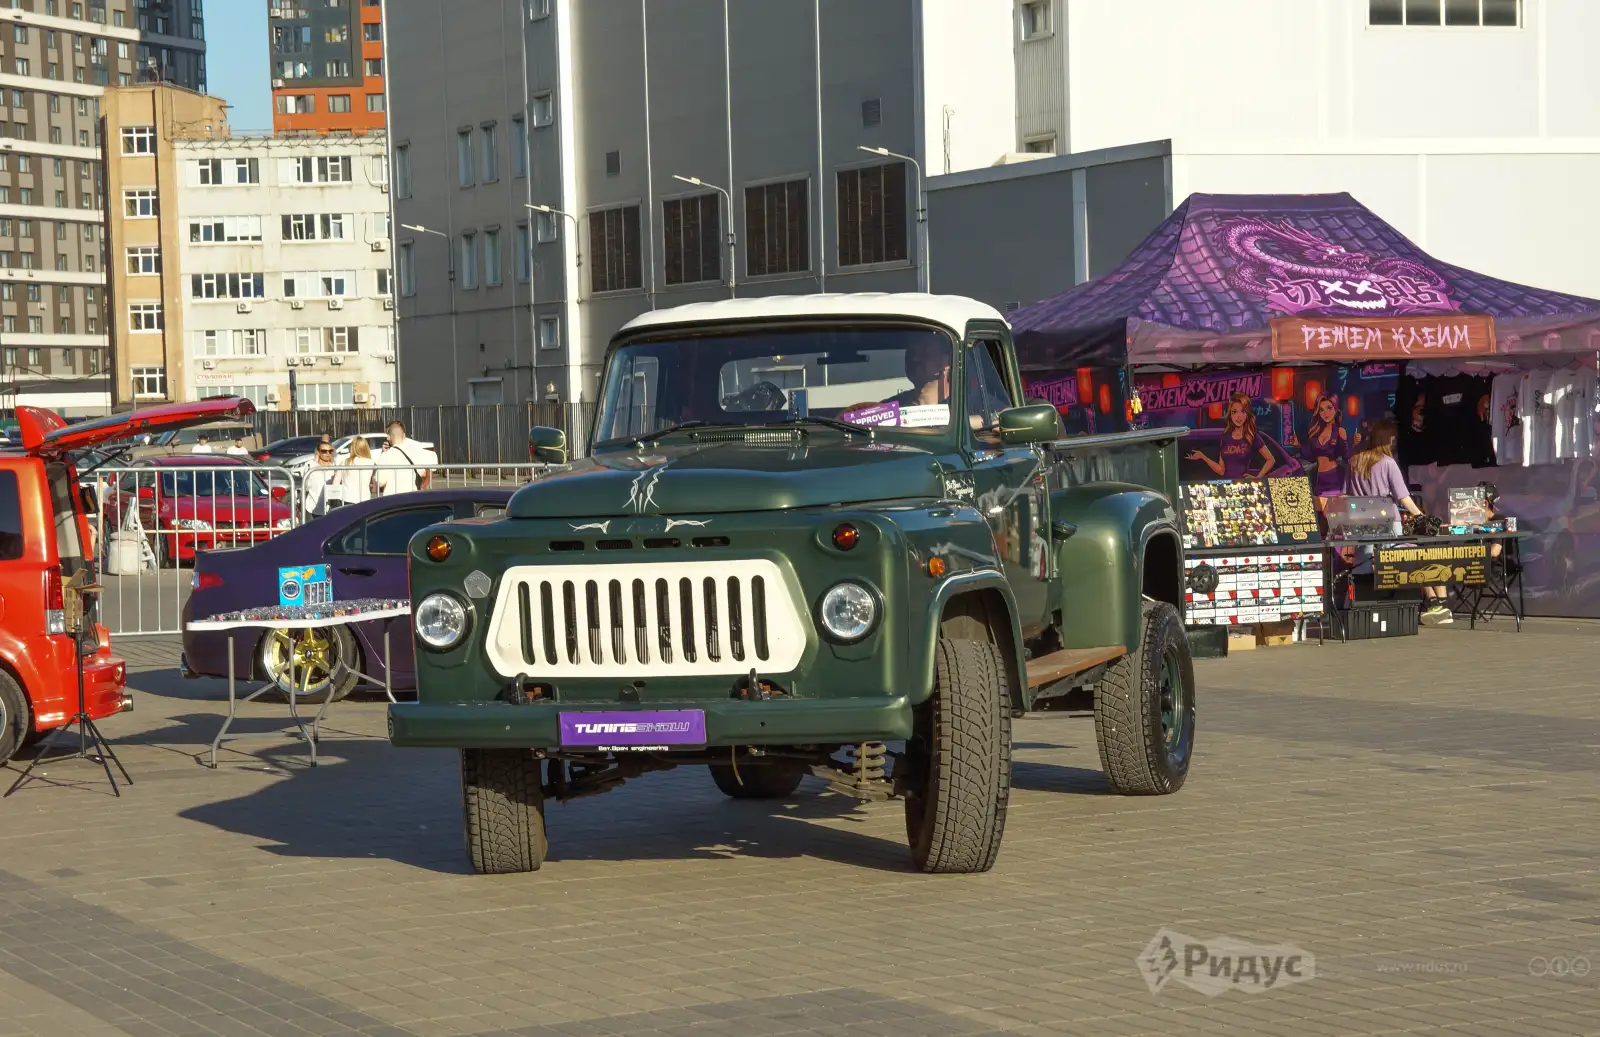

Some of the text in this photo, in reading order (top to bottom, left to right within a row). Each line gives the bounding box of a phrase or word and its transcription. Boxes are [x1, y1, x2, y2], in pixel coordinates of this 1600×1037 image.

[1301, 324, 1472, 354] РЕЖЕМ КЛЕИМ
[1141, 375, 1262, 409] РЕЖЕМ КЛЕИМ
[1380, 545, 1486, 562] БЕСПРОИГРЫШНАЯ ЛОТЕРЕЯ
